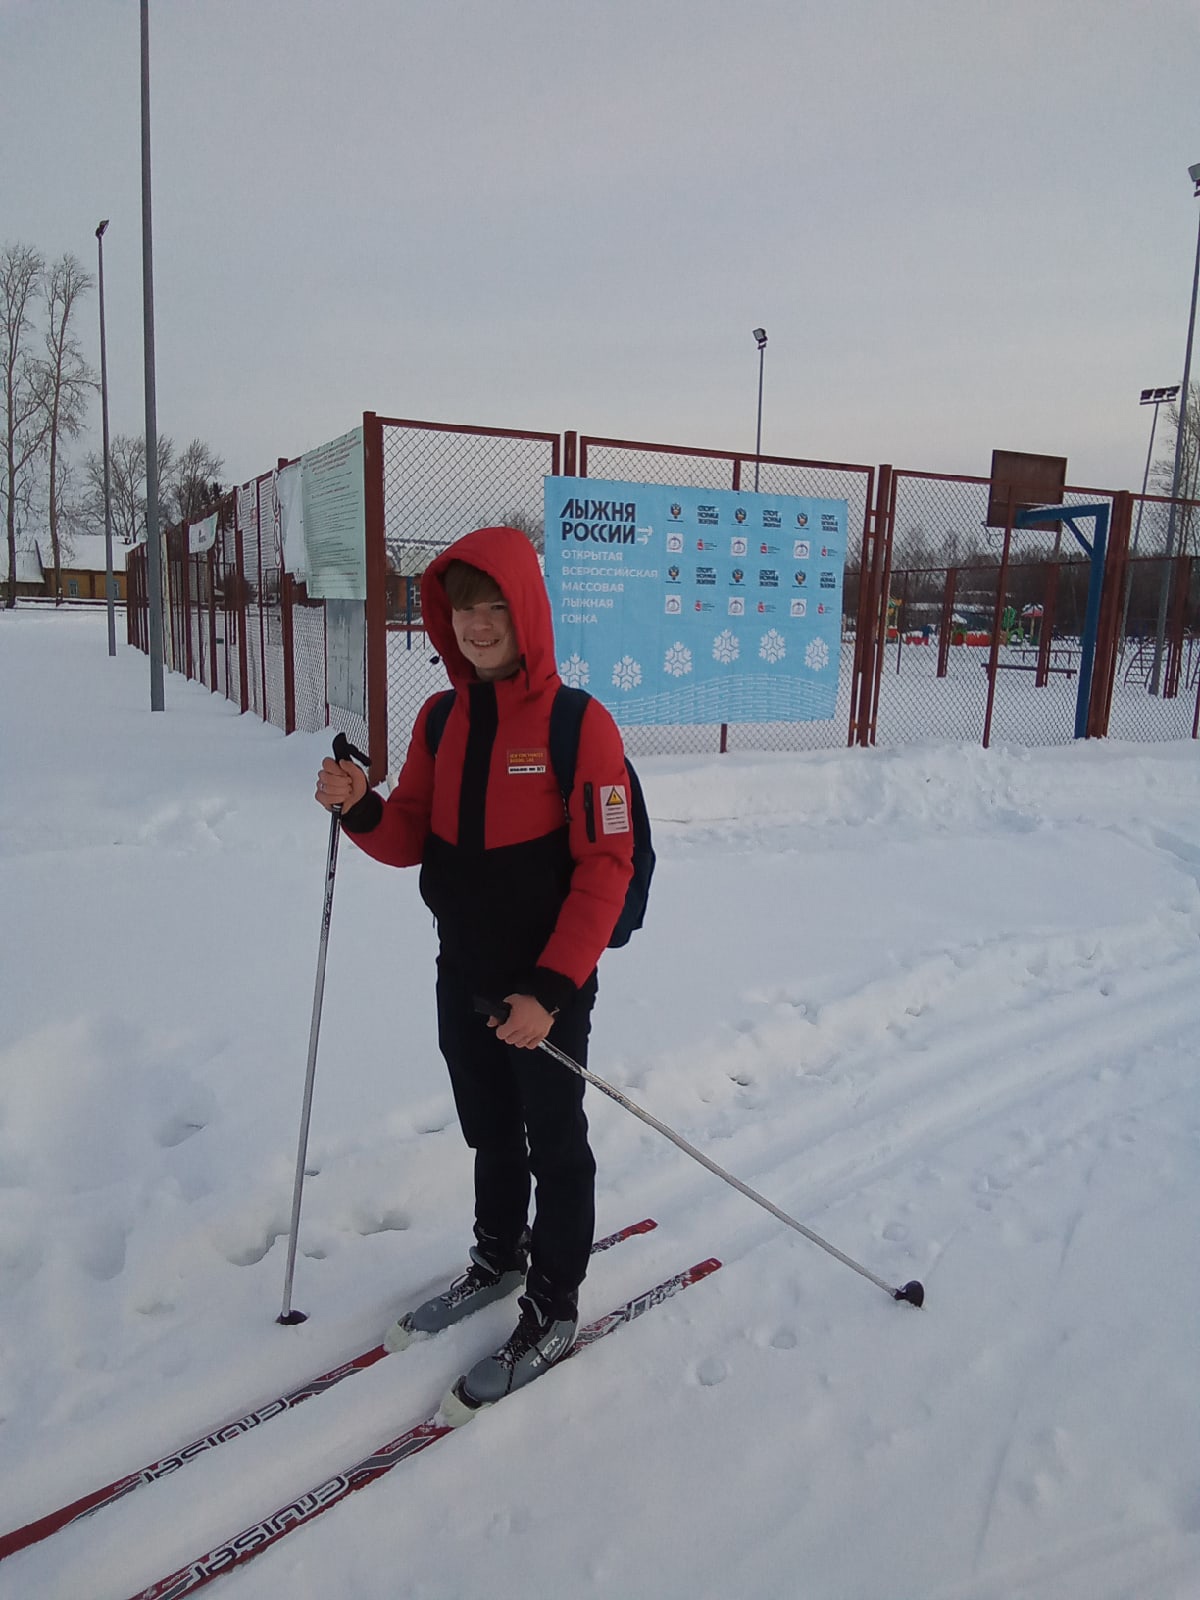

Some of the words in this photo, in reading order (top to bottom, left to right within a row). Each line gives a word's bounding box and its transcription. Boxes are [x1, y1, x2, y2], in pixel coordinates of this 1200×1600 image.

[560, 498, 636, 522] ЛЫЖНЯ
[562, 521, 636, 544] РОССИИ
[561, 549, 624, 561] ОТКРЫТАЯ
[562, 566, 658, 578] ВСЕРОССИЙСКАЯ
[562, 582, 625, 592] МАССОВАЯ
[562, 597, 614, 608] ЛЫЖНАЯ
[561, 614, 598, 624] ГОНКА
